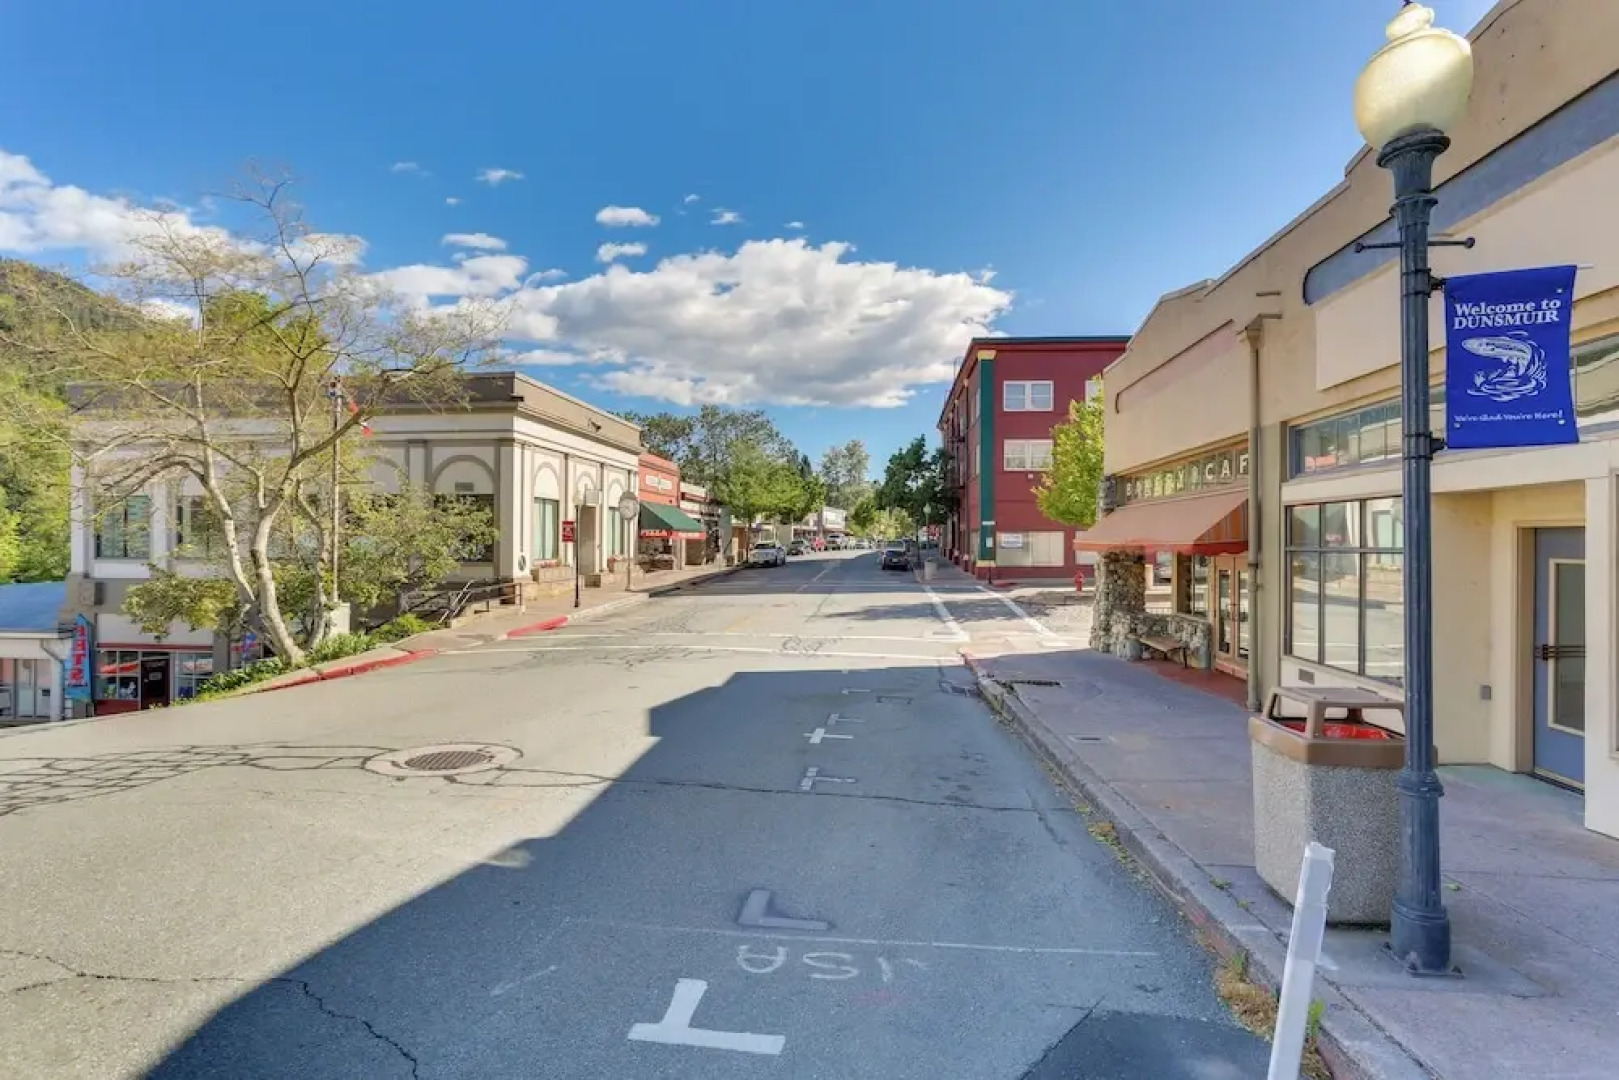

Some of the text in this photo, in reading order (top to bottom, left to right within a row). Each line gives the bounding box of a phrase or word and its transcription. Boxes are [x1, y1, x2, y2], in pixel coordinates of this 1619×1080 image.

[1454, 298, 1561, 316] Welcome to
[1453, 310, 1560, 330] DUNSMUIR
